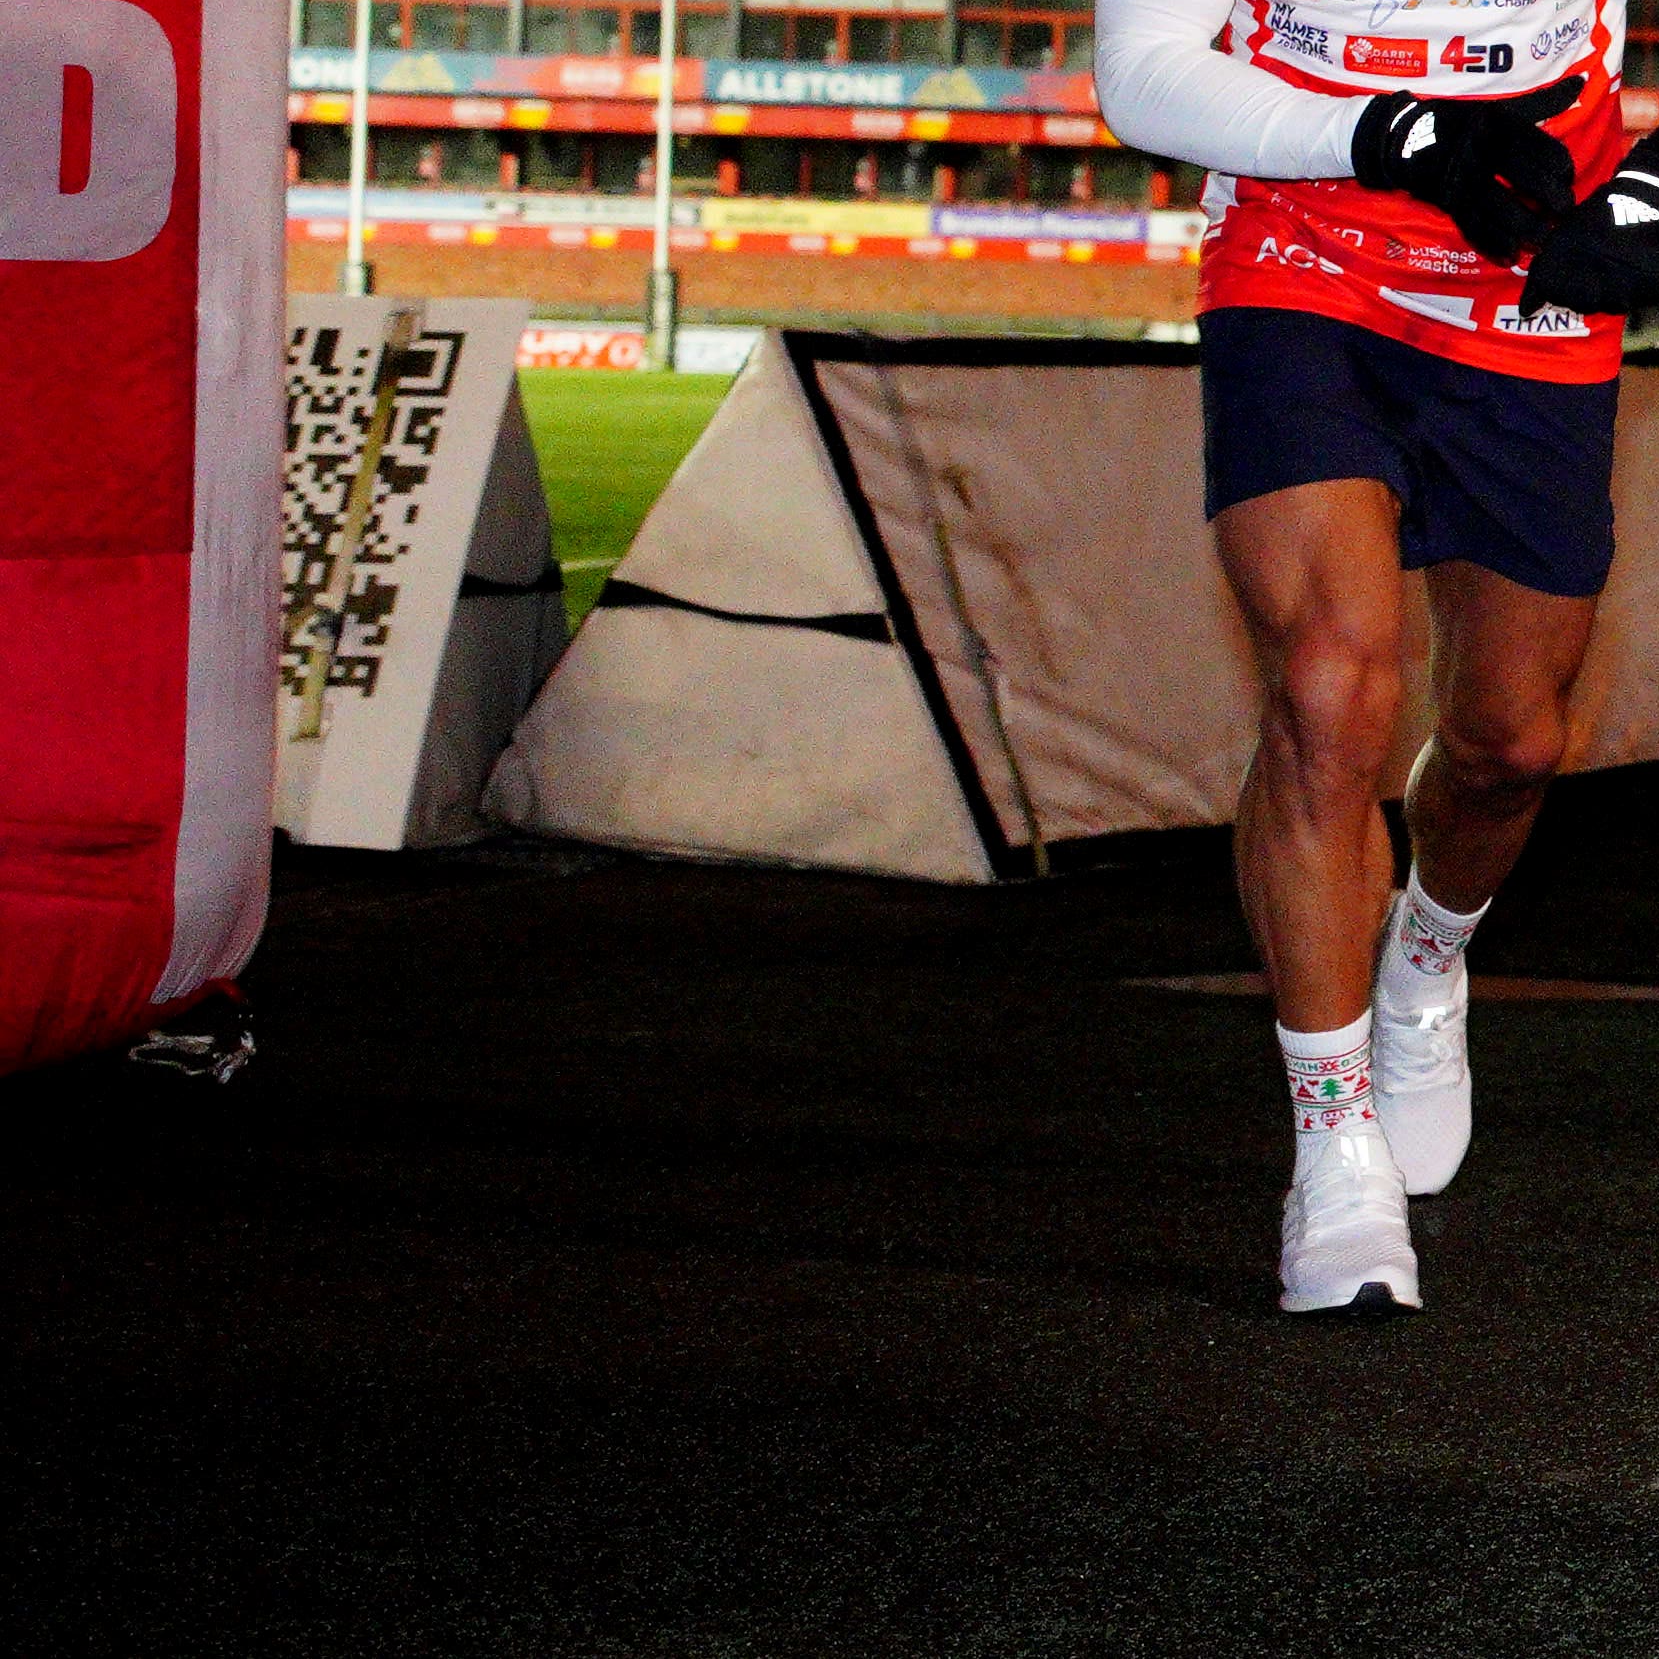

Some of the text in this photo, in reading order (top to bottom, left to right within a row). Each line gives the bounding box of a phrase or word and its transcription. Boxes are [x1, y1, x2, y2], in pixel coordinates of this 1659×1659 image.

[1273, 2, 1296, 17] MY
[1270, 16, 1328, 43] NAME'S
[1373, 49, 1414, 59] DARBY
[1409, 245, 1478, 264] business
[1408, 258, 1459, 274] waste
[1500, 310, 1571, 332] TITAN
